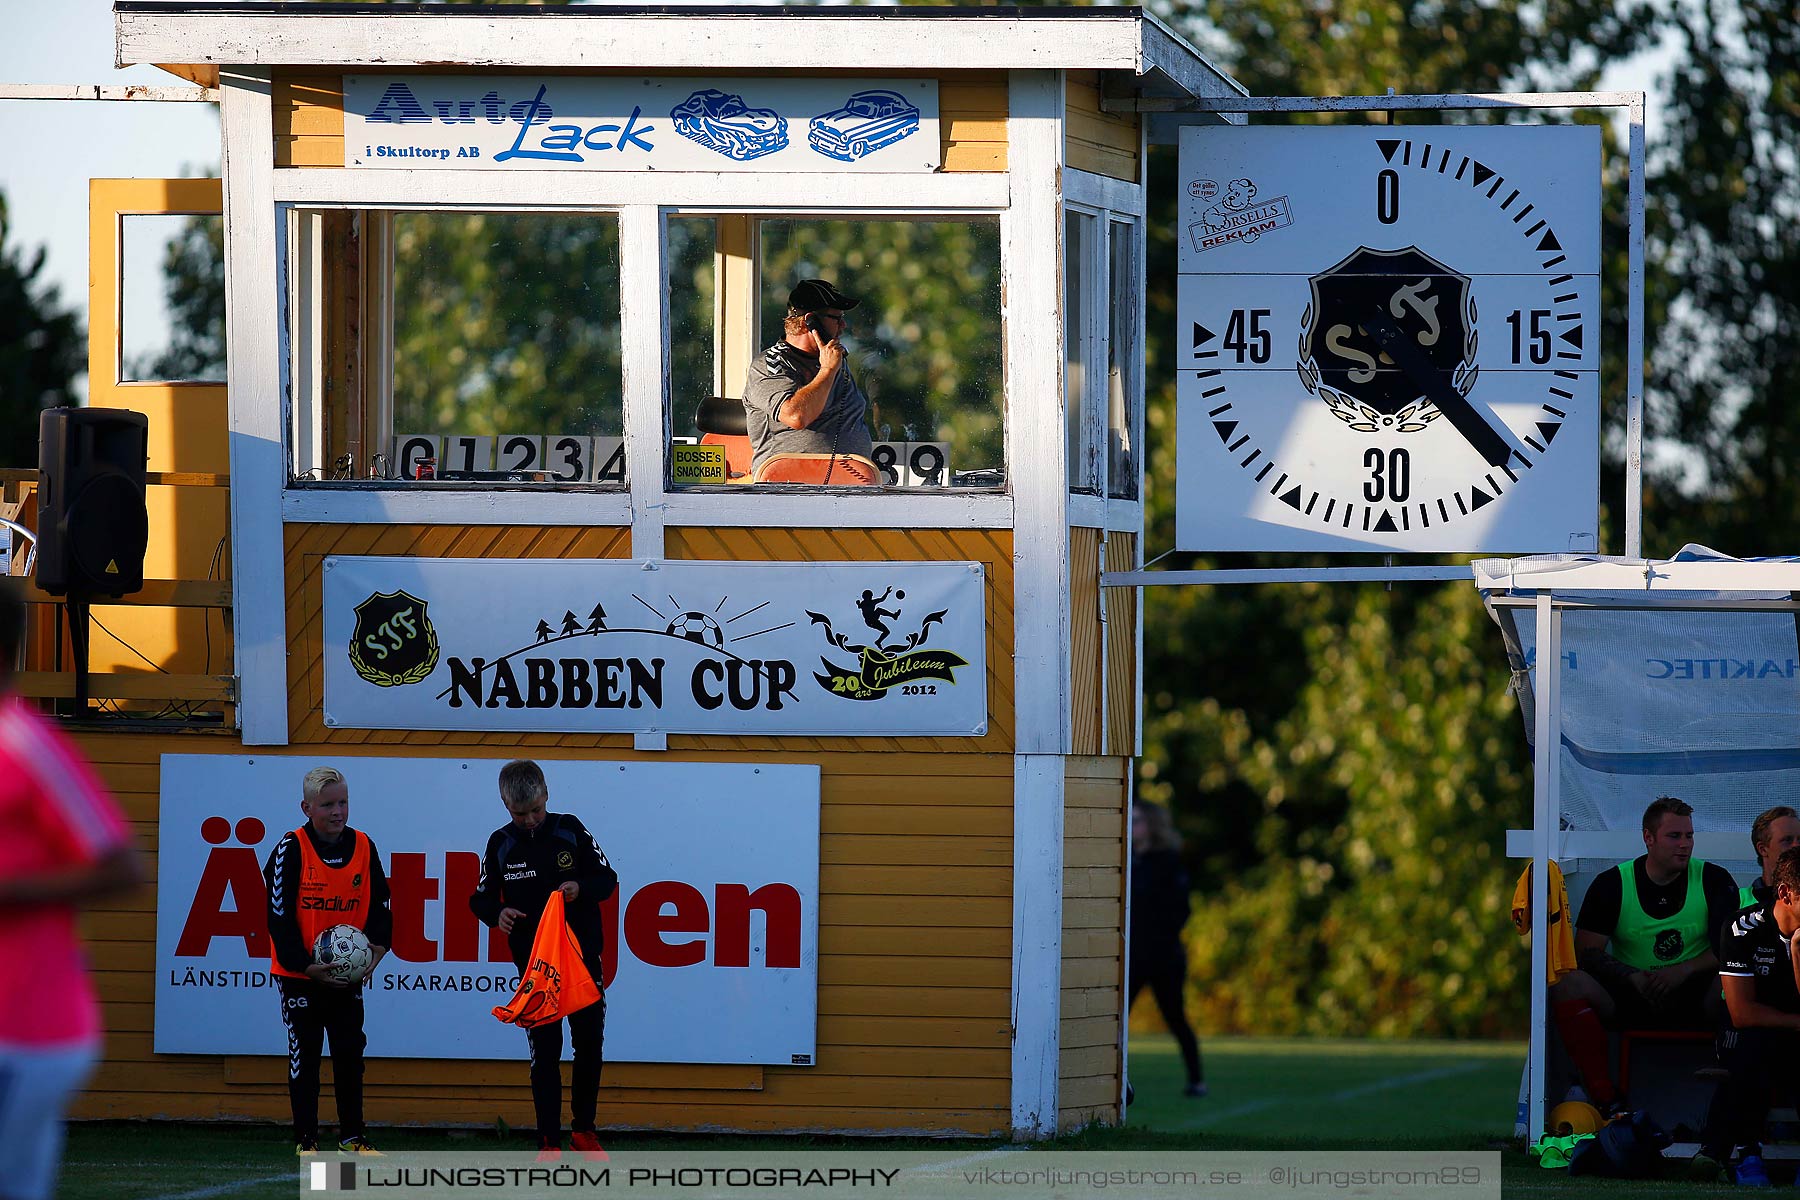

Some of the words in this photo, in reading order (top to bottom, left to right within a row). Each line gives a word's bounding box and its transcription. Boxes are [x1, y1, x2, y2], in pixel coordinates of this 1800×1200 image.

[365, 82, 553, 125] Auto
[493, 84, 655, 163] Lack
[366, 145, 372, 157] i
[376, 145, 451, 160] Skultorp
[456, 146, 481, 158] AB
[1377, 169, 1399, 225] 0
[1202, 220, 1277, 248] REKLAM
[1223, 309, 1271, 364] 45
[1506, 310, 1552, 365] 15
[676, 451, 721, 463] BOSSE's
[676, 466, 722, 477] SNACKBAR
[1363, 448, 1410, 502] 30
[446, 657, 666, 709] NABBEN
[690, 659, 797, 710] CUP
[831, 676, 859, 692] 20
[874, 658, 945, 688] Jubileum
[902, 685, 936, 695] 2012
[503, 869, 537, 881] stadium
[287, 997, 308, 1009] CG
